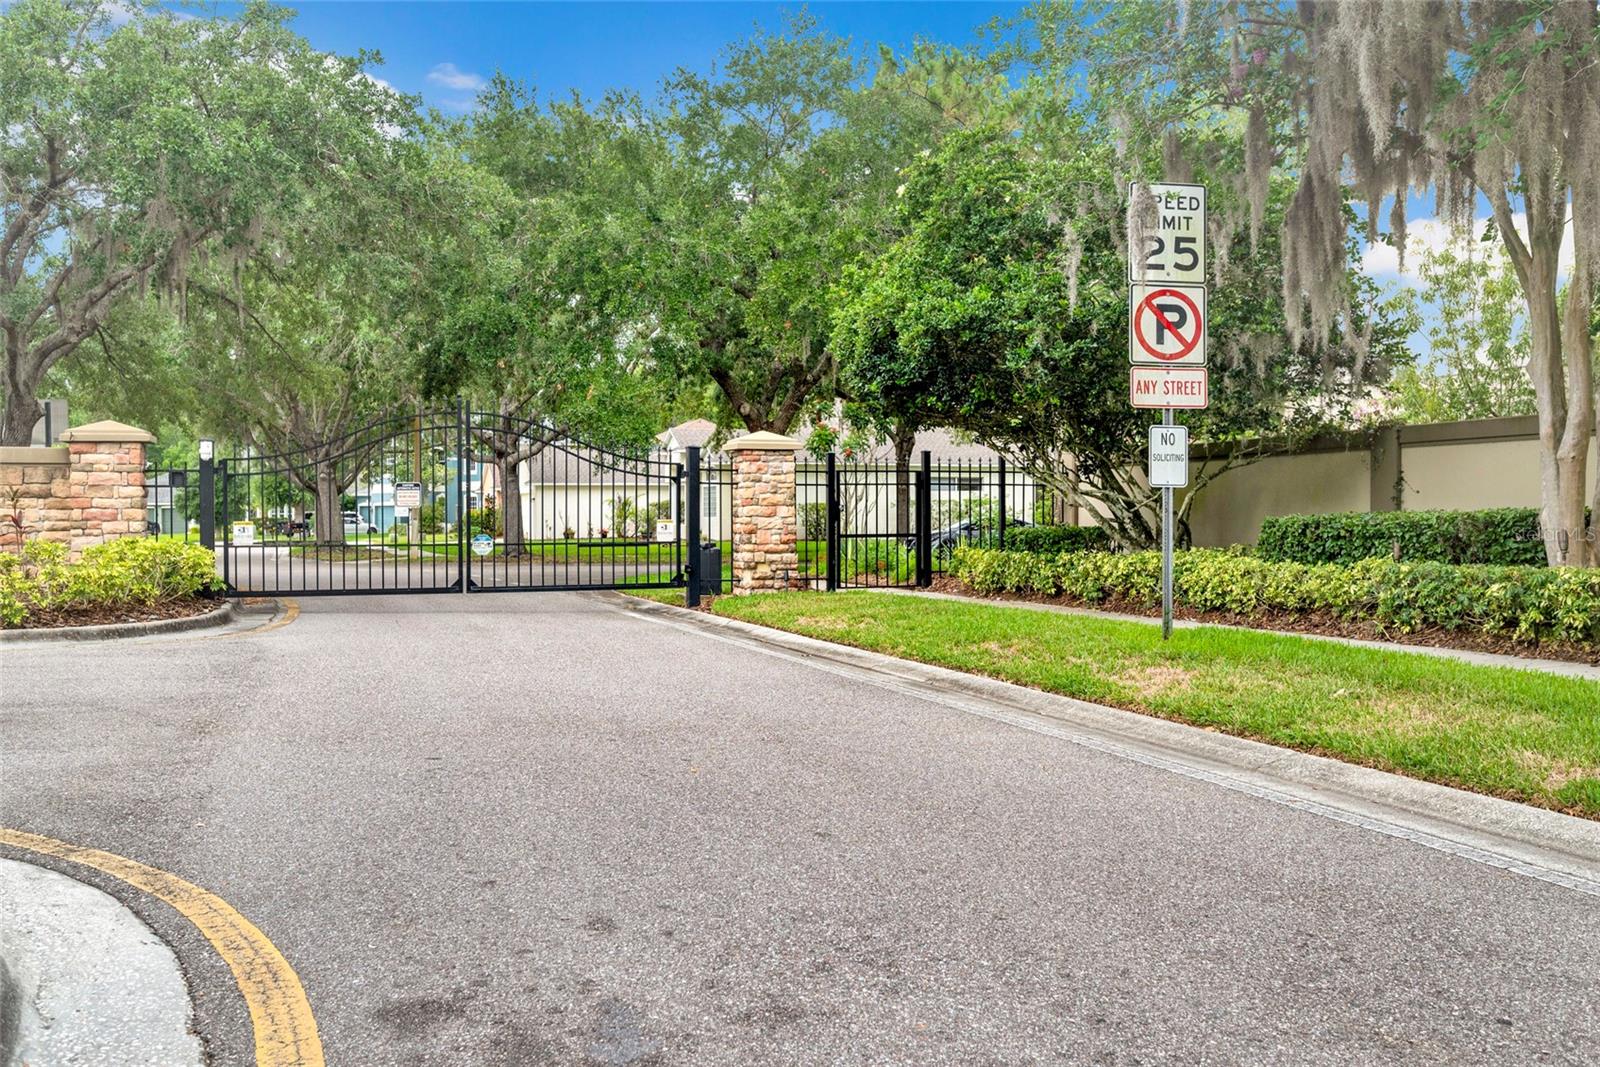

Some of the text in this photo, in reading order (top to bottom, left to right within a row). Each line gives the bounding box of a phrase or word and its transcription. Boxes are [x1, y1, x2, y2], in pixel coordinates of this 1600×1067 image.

[1153, 195, 1200, 211] PEED
[1157, 216, 1192, 231] IMIT
[1143, 236, 1199, 272] 25
[1136, 380, 1202, 396] ANY STREET
[1160, 432, 1176, 446] NO
[1152, 453, 1185, 463] SOLICITING
